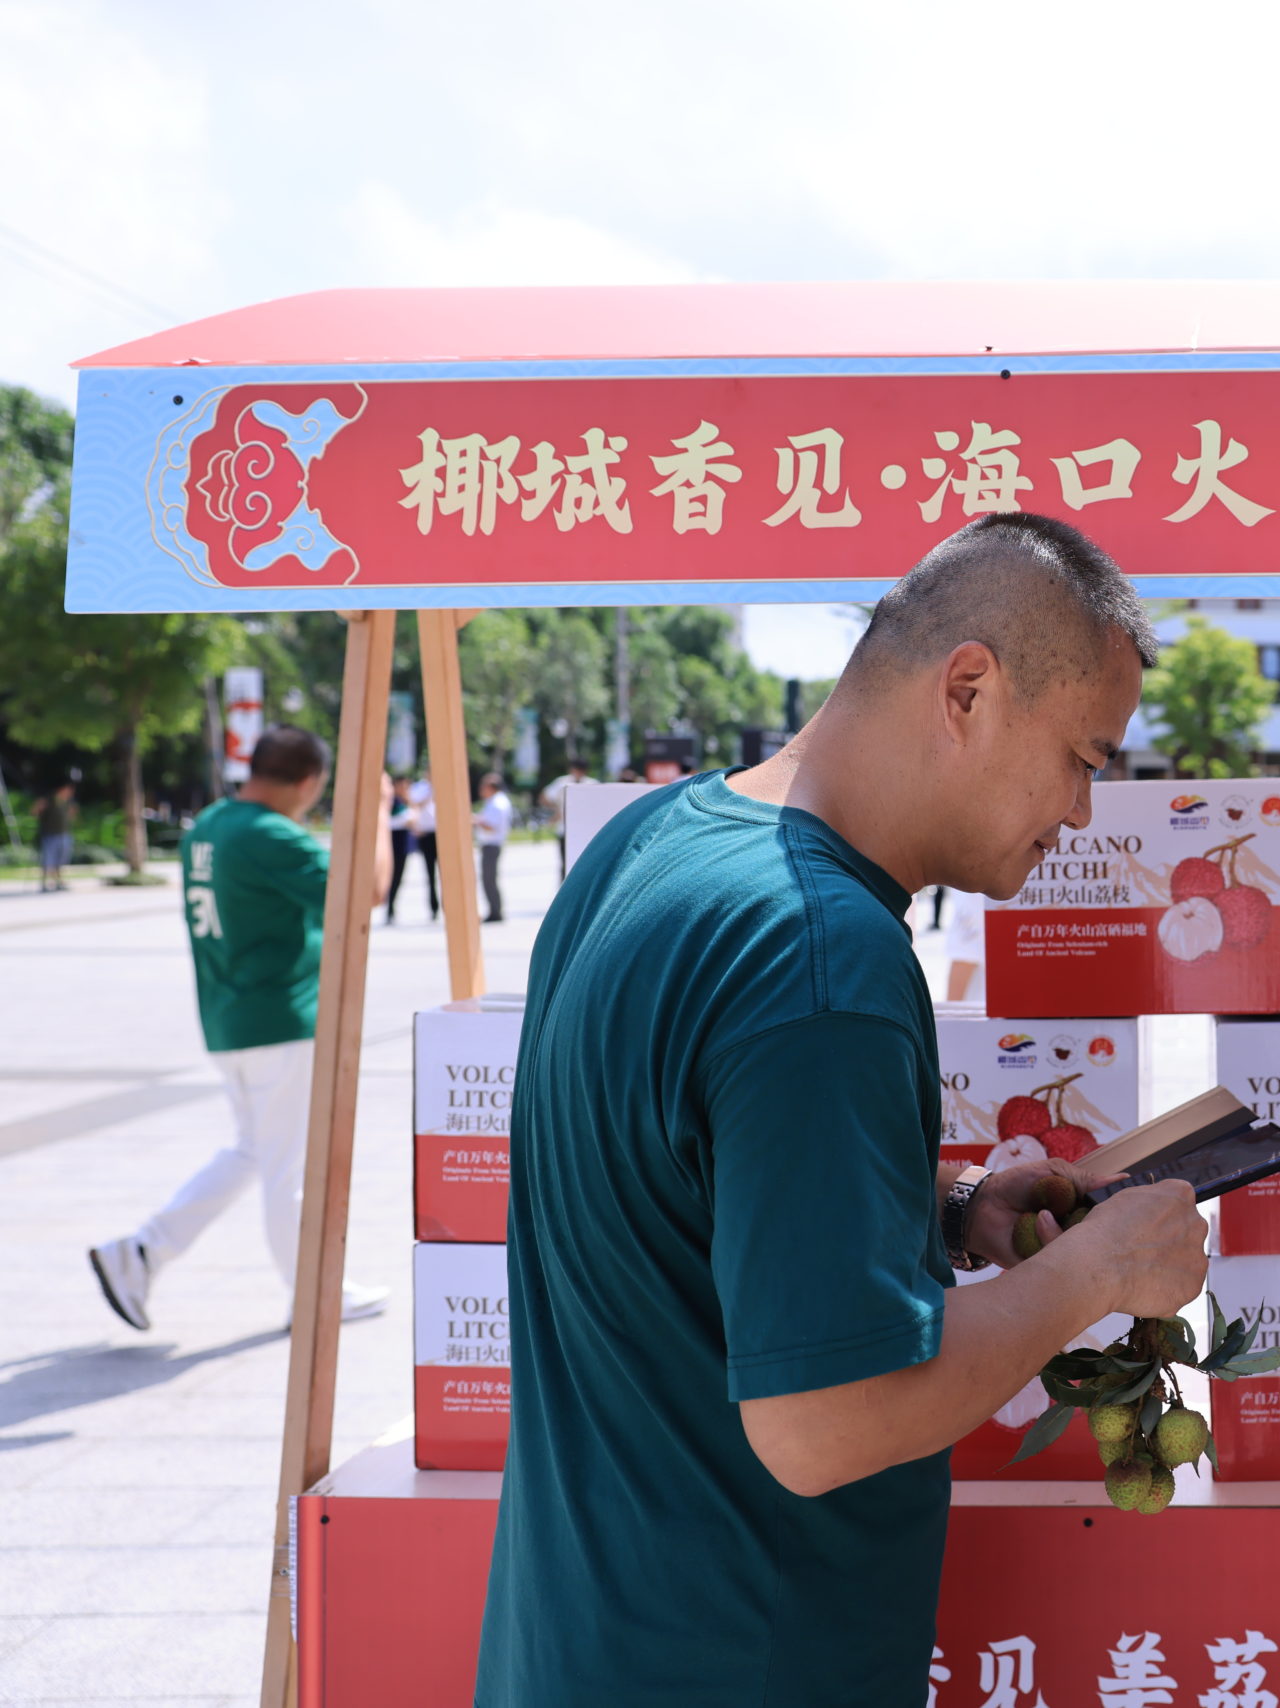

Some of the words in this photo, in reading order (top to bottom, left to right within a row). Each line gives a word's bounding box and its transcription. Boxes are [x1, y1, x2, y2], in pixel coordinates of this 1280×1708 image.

[1046, 835, 1142, 855] LCANO
[1028, 861, 1108, 881] ITCHI
[1019, 884, 1131, 905] 海口火山荔枝
[445, 1065, 515, 1084] VOLC
[448, 1090, 512, 1109] LITC
[445, 1296, 509, 1316] VOLC
[447, 1321, 510, 1339] LITC
